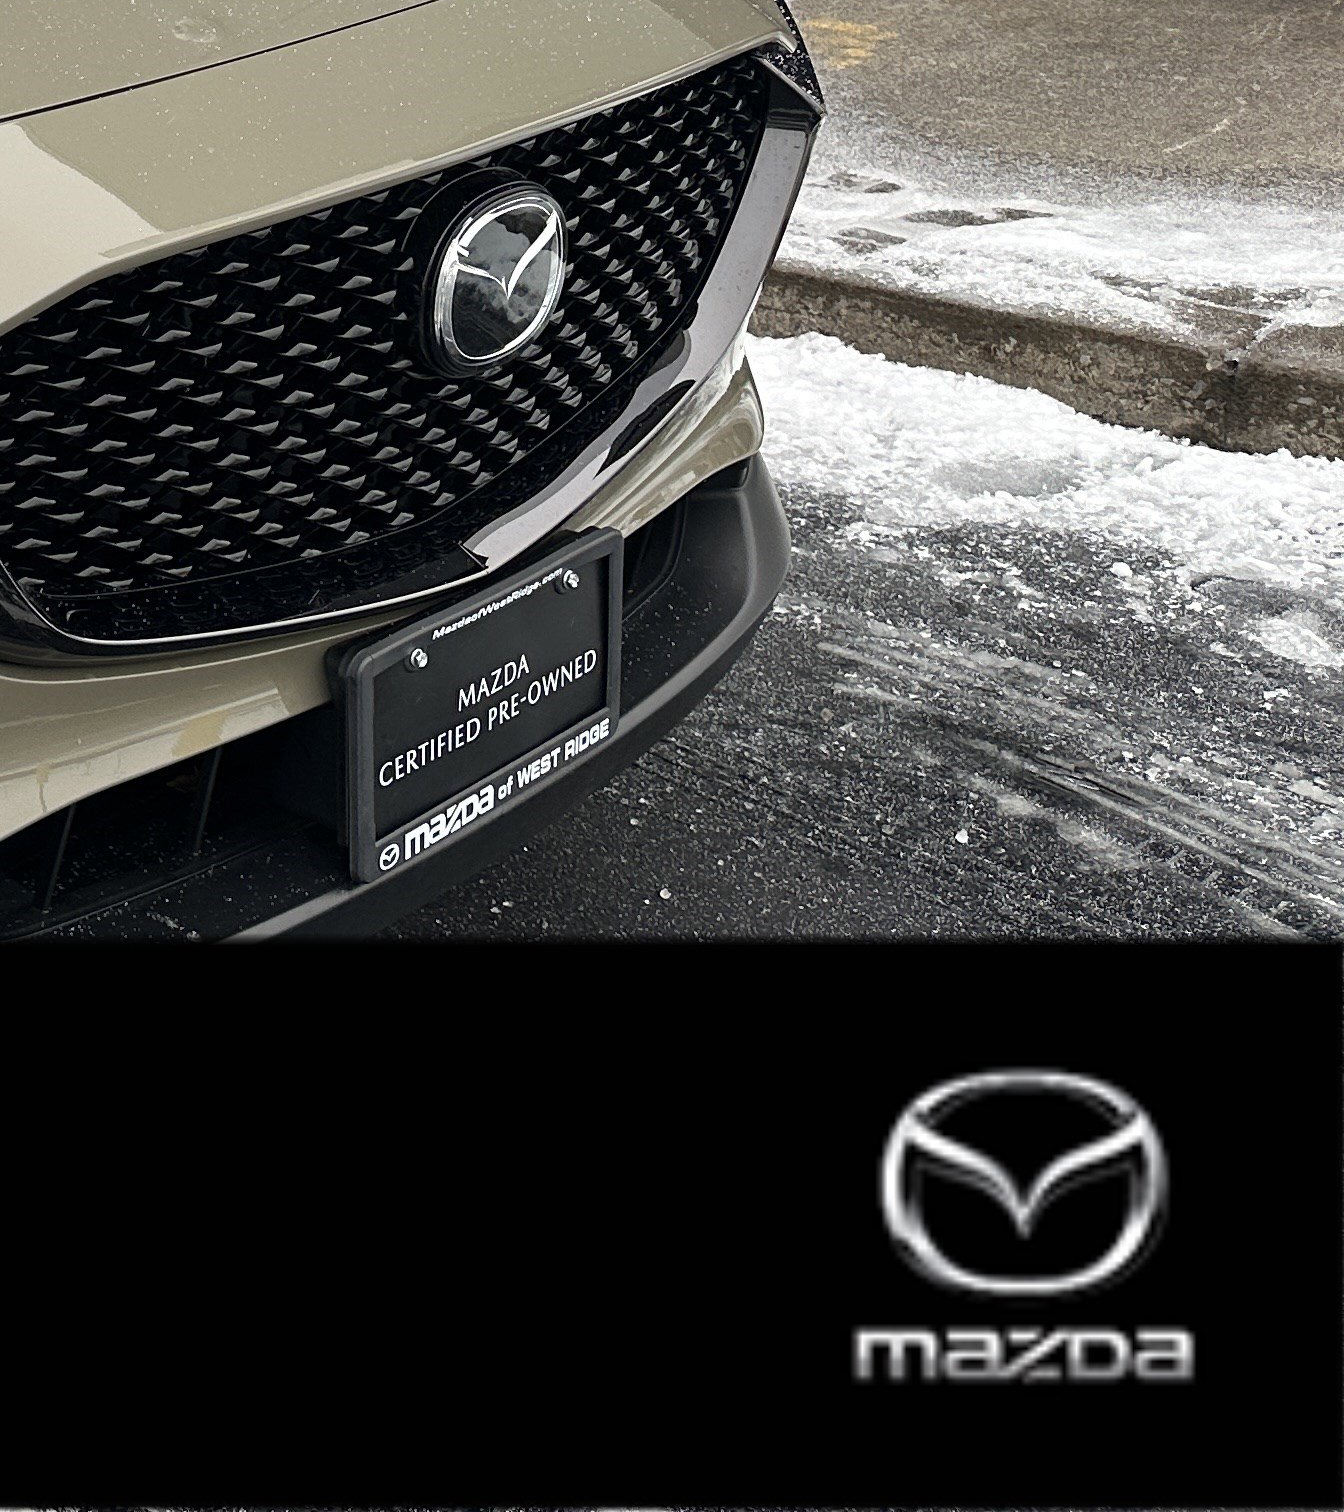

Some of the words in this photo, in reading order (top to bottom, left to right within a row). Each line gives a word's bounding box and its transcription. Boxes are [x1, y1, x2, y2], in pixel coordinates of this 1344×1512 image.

[378, 717, 481, 787] CERTIFIED
[488, 649, 597, 731] PRE-OWNED
[458, 654, 530, 712] MAZDA
[498, 775, 514, 801] of
[517, 746, 561, 789] WEST
[564, 717, 610, 762] RIDGE
